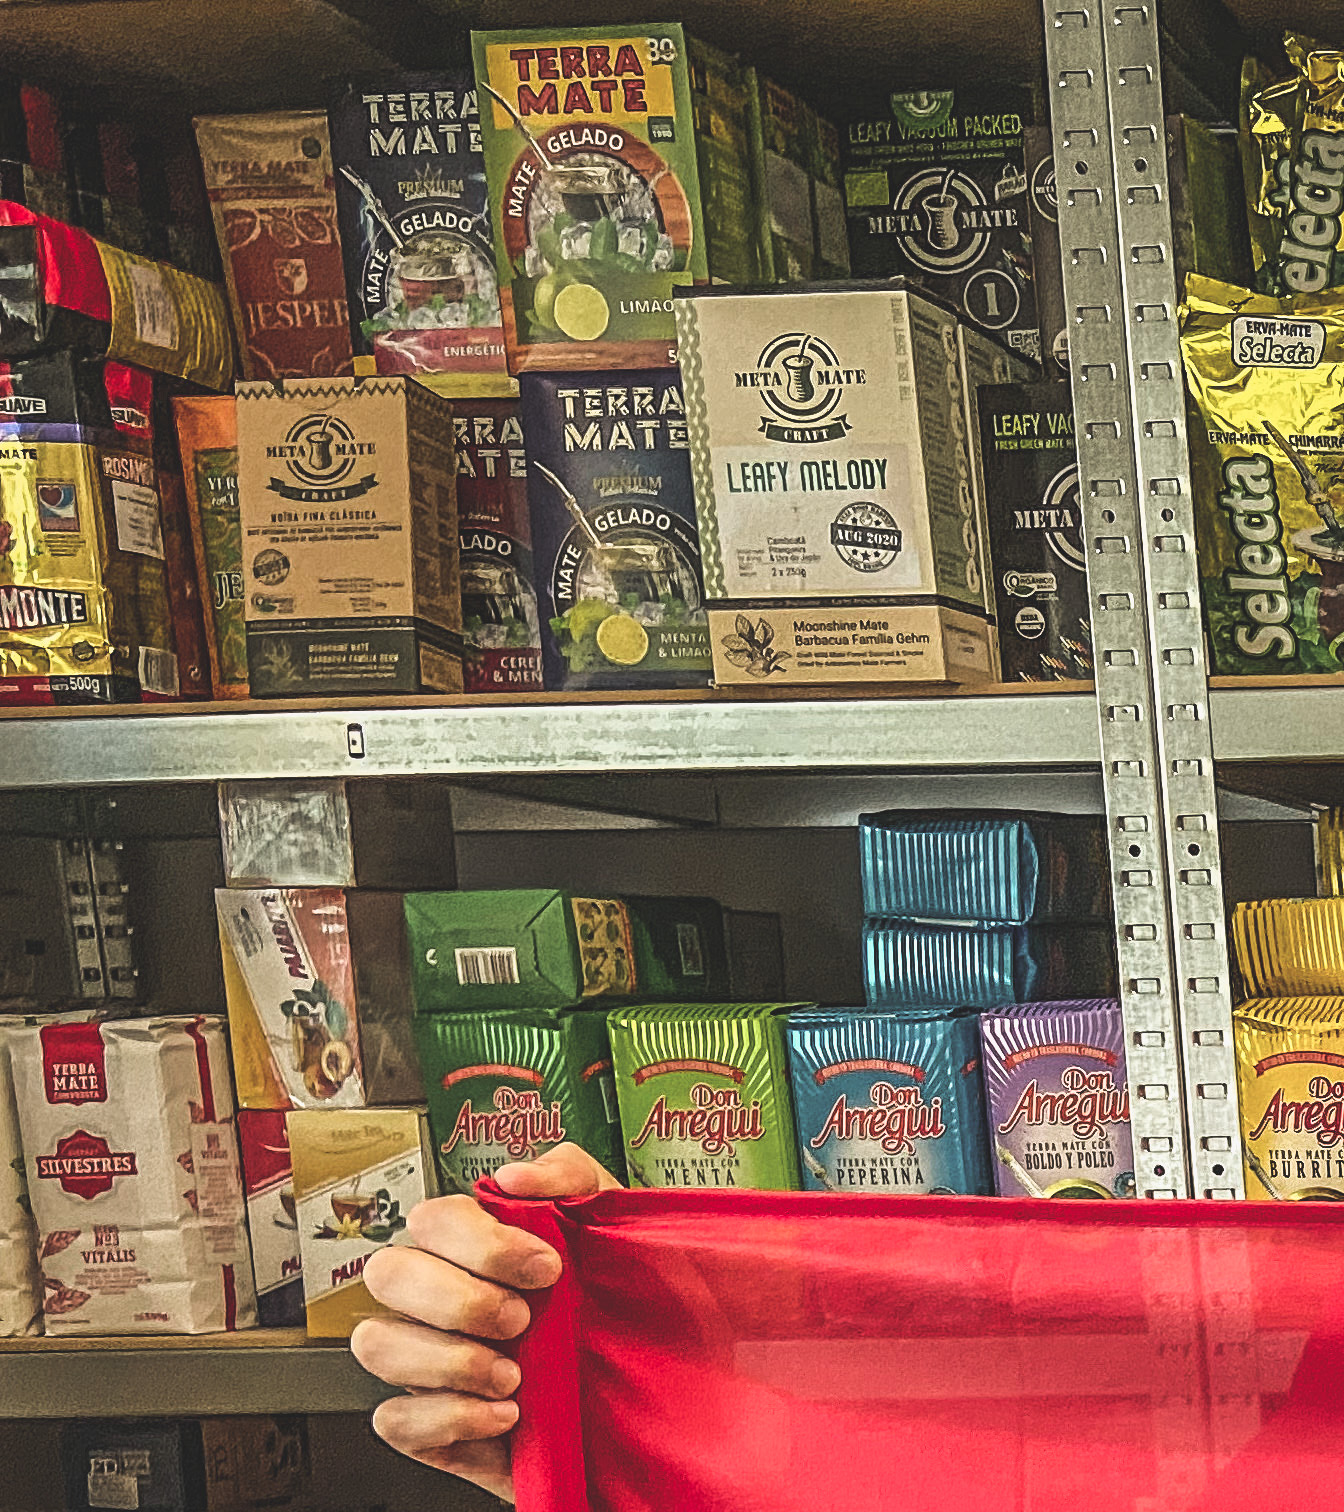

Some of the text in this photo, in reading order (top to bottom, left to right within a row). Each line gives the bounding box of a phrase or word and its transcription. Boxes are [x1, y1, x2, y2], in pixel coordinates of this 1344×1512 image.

[510, 45, 645, 82] TERRA
[518, 79, 648, 115] MATE
[547, 128, 624, 154] GELADO
[508, 161, 538, 218] MATE
[401, 214, 472, 236] GELADO
[869, 209, 1018, 233] META MATE
[367, 249, 388, 303] MATE
[1246, 321, 1312, 338] ERVA-MATE
[1239, 338, 1316, 364] Selecta
[735, 368, 866, 388] META MATE
[994, 413, 1040, 436] LEAFY
[727, 459, 887, 493] LEAFY MELODY
[594, 509, 670, 533] GELADO
[1014, 510, 1074, 529] META
[1232, 456, 1295, 659] Selecta
[557, 545, 583, 600] MATE
[69, 678, 100, 692] 500g
[53, 1064, 97, 1076] YERBA
[1062, 1066, 1114, 1092] Don
[53, 1075, 98, 1091] MATE
[691, 1082, 741, 1108] Don
[870, 1082, 920, 1108] Don
[495, 1086, 542, 1109] Don
[442, 1100, 565, 1158] Arregui
[630, 1096, 765, 1156] Arregui
[810, 1097, 945, 1154] Arregui
[39, 1155, 132, 1175] SILVESTRES
[1025, 1151, 1114, 1170] BOLDO Y POLEO
[664, 1168, 736, 1186] MENTA
[837, 1167, 925, 1186] PEPERINA
[82, 1249, 136, 1264] VITALIS
